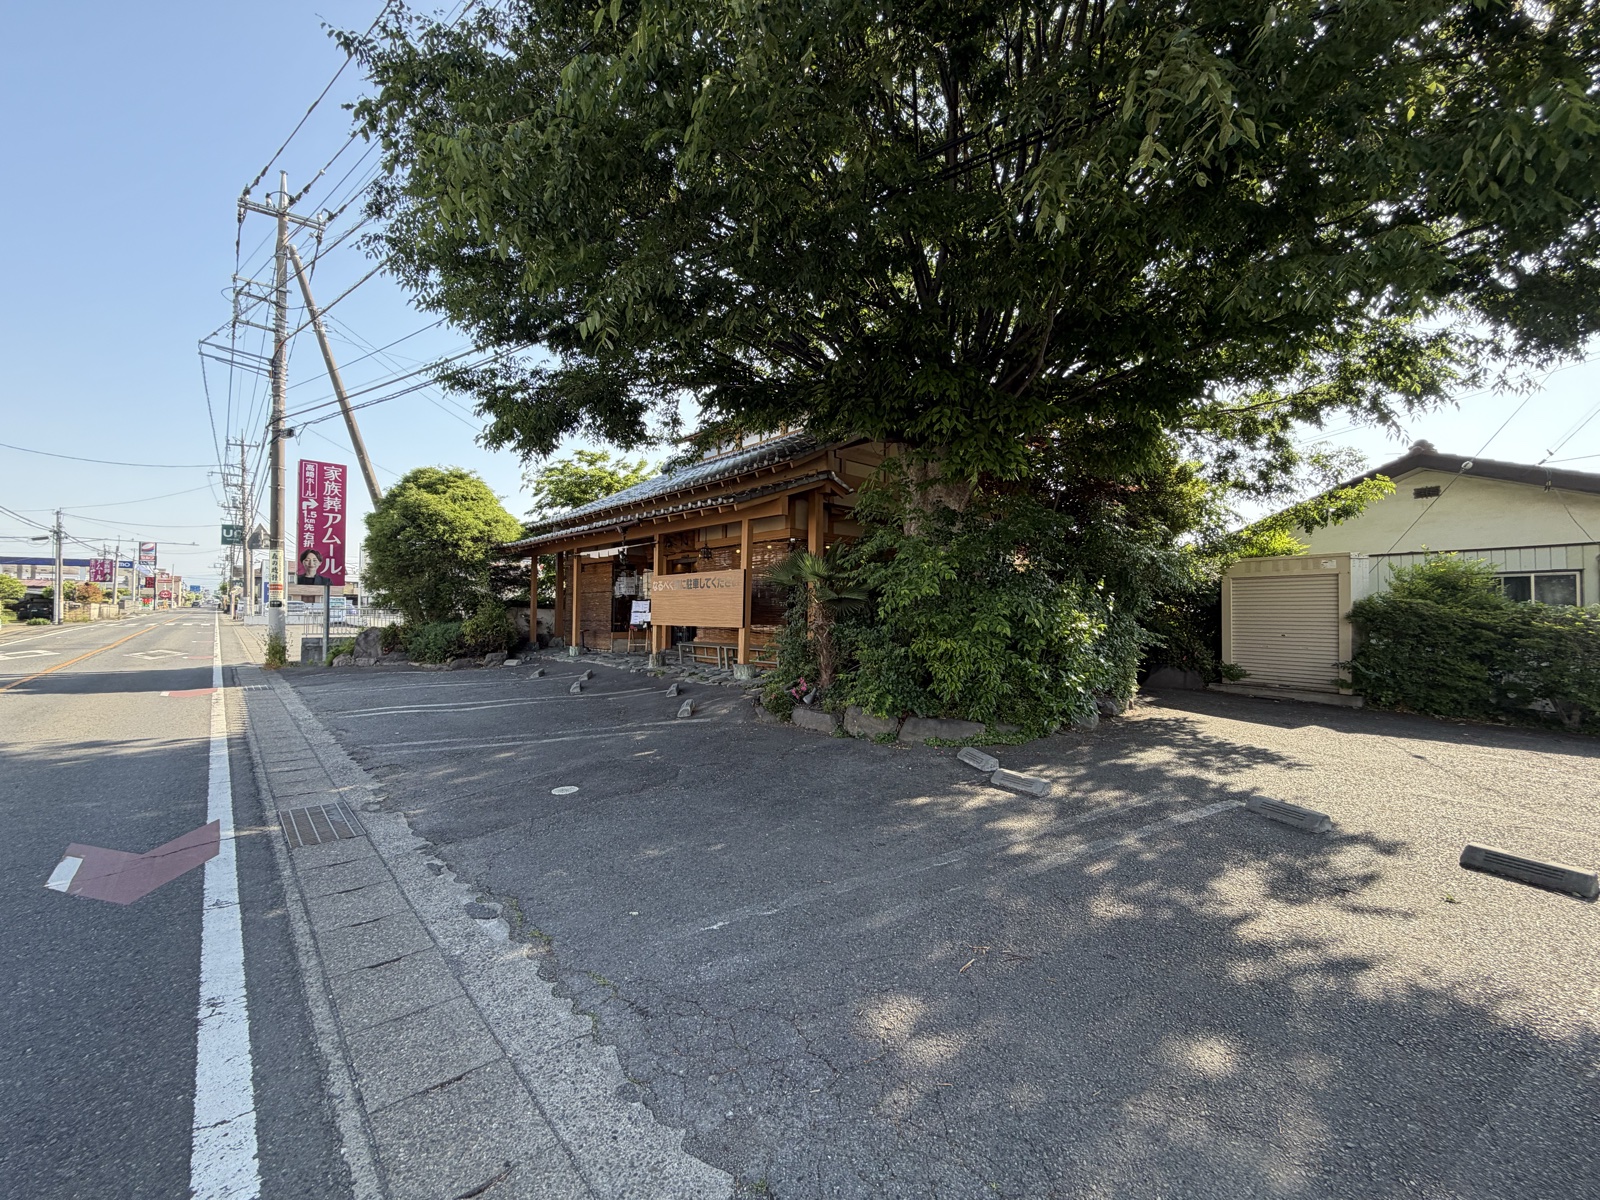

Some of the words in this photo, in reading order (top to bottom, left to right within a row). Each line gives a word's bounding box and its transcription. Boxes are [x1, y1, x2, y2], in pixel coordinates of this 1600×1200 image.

[305, 464, 315, 497] 高崎ホール
[321, 466, 342, 574] 家族葬アムール
